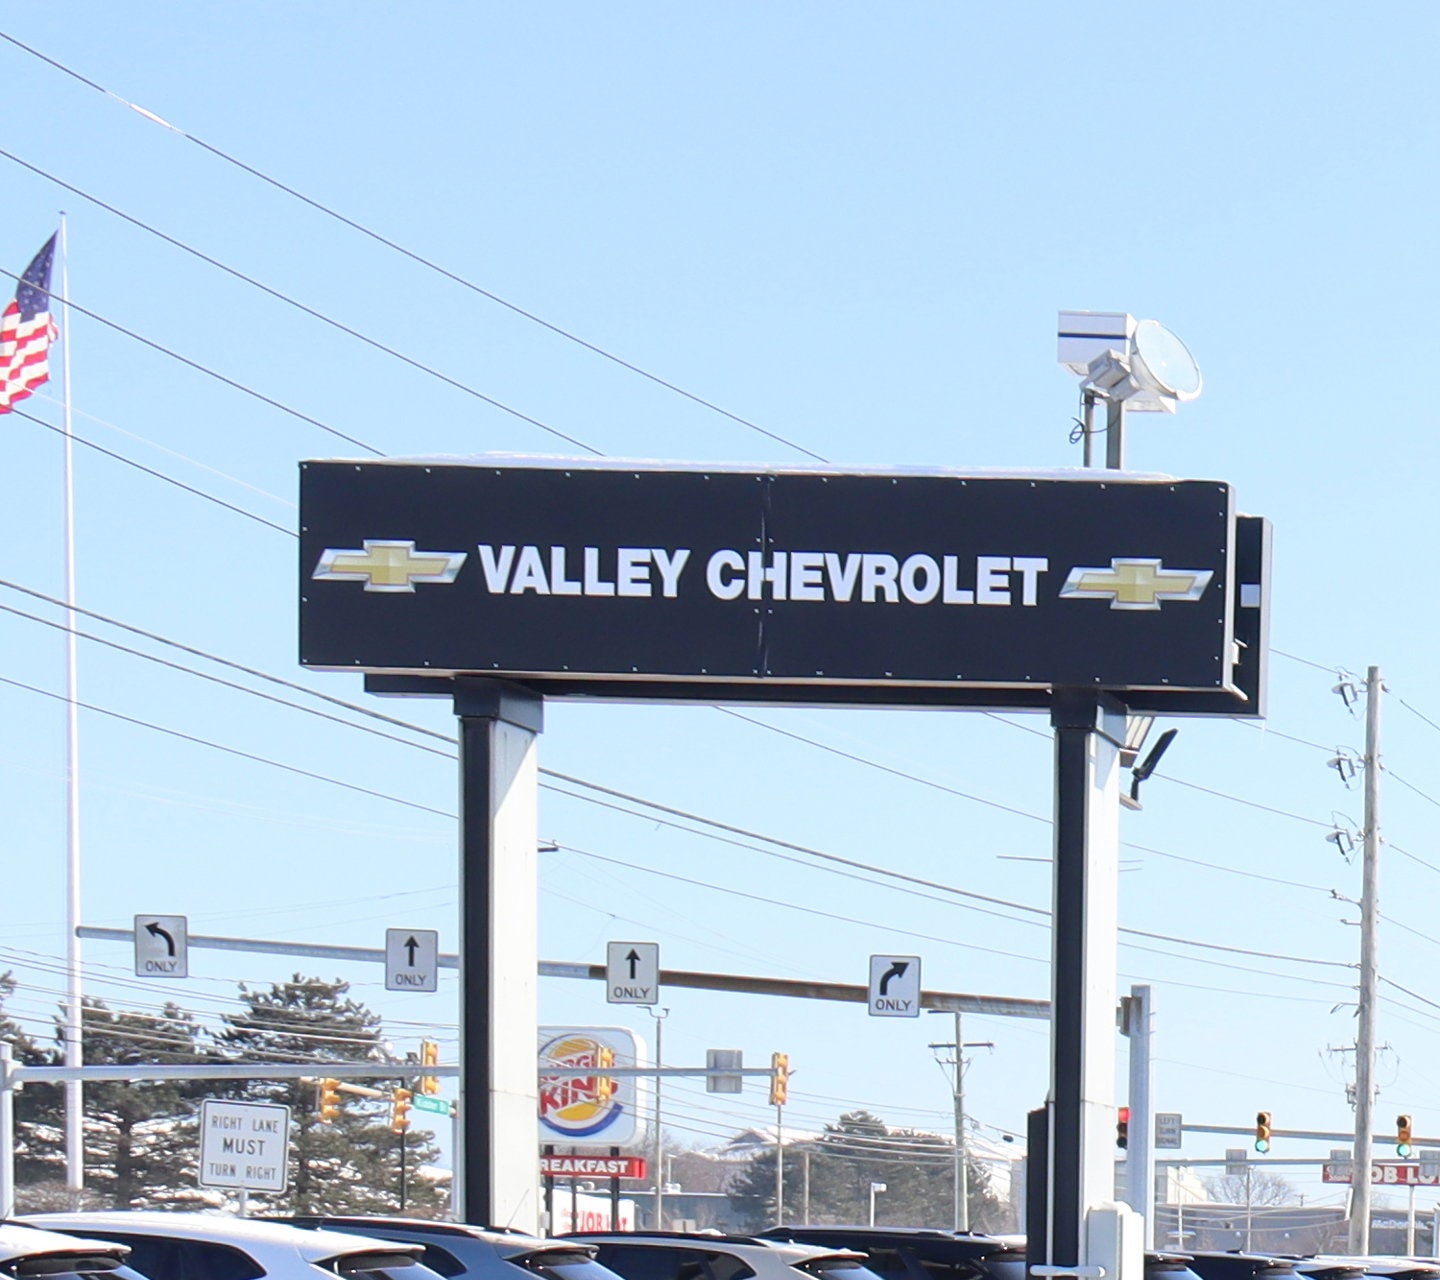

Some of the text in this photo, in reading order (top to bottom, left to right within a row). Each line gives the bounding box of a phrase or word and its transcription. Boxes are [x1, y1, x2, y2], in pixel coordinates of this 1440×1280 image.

[477, 544, 1049, 607] VALLEY CHEVROLET
[145, 959, 177, 973] ONLY
[394, 973, 427, 987] ONLY
[613, 986, 650, 1000] ONLY
[875, 998, 911, 1012] ONLY
[211, 1115, 278, 1133] RIGHT LANE
[222, 1137, 266, 1156] MUST
[209, 1162, 277, 1180] TURN RIGHT
[540, 1160, 628, 1174] REAKFAST
[1371, 1165, 1398, 1183] OB
